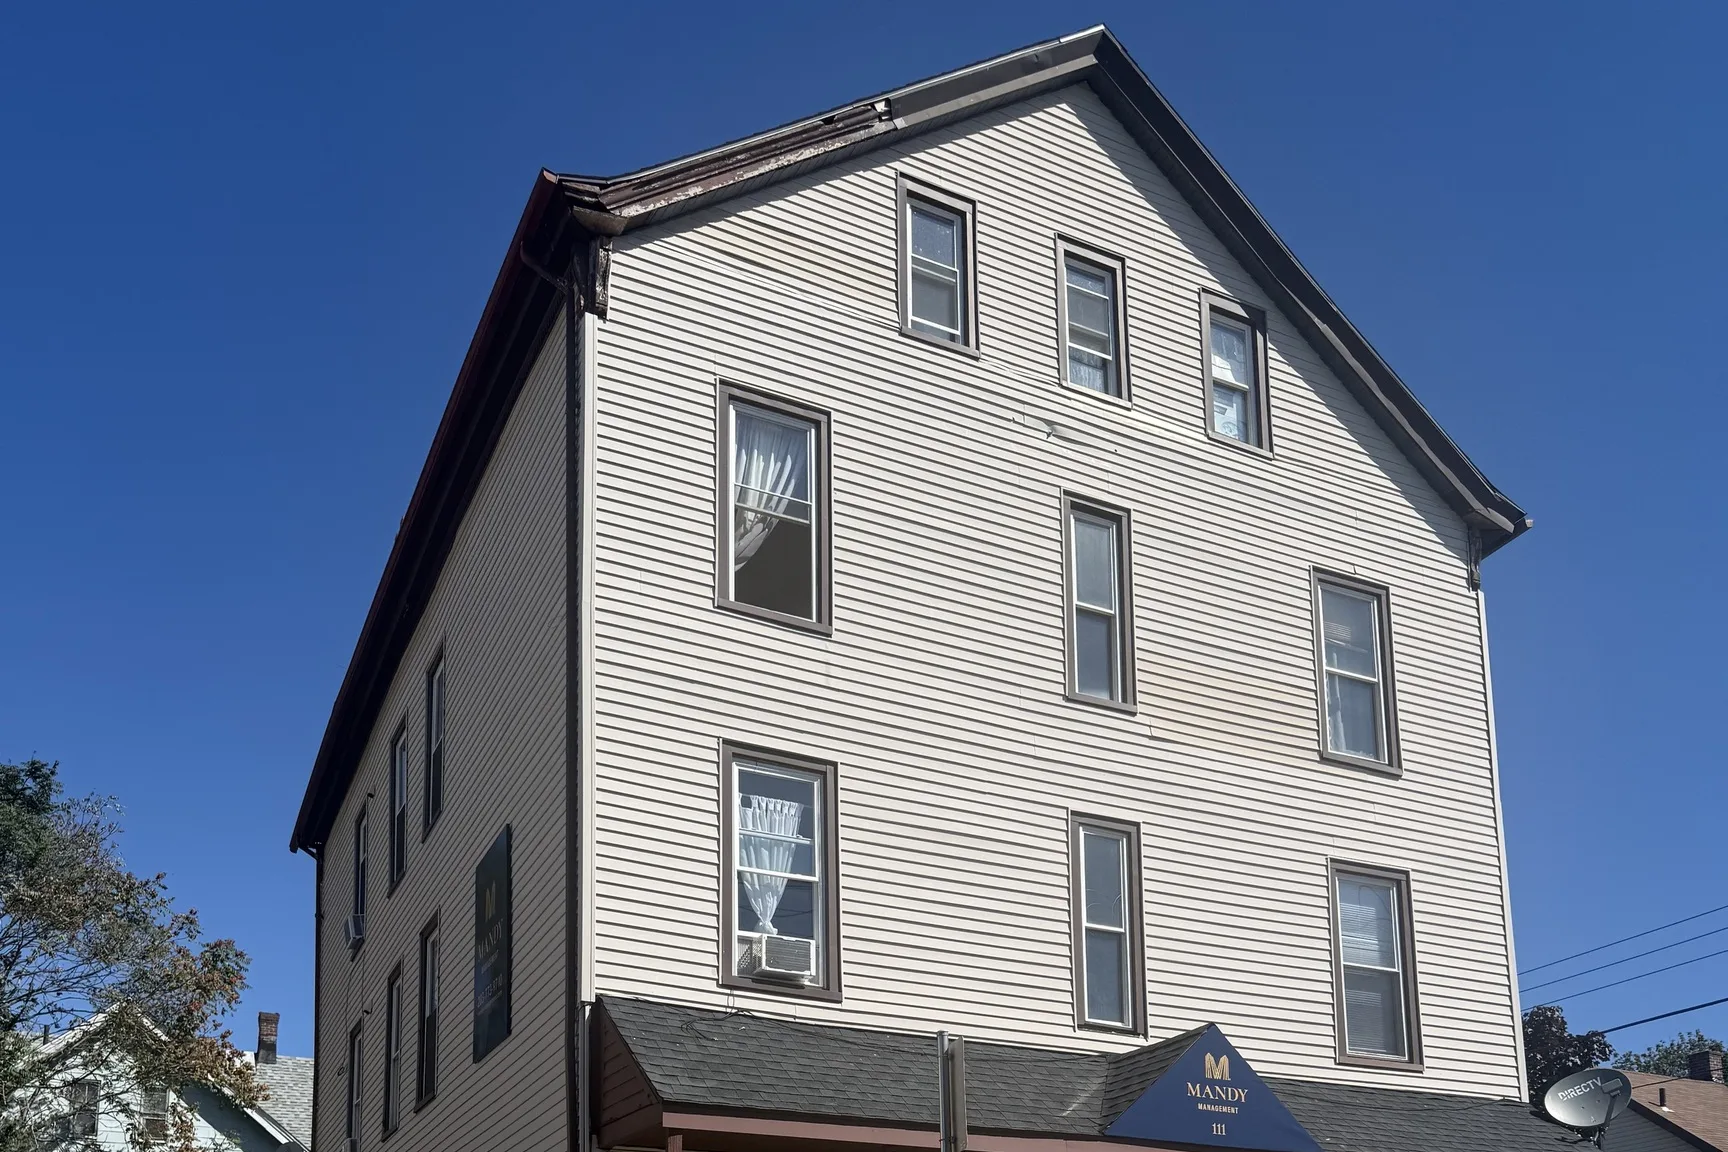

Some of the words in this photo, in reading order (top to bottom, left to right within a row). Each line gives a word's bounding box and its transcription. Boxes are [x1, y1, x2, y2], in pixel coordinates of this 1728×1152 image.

[1186, 1081, 1248, 1103] MANDY
[1557, 1076, 1602, 1102] DIRECTV
[1198, 1103, 1239, 1114] MANAGEMENT
[1211, 1122, 1226, 1136] 111
